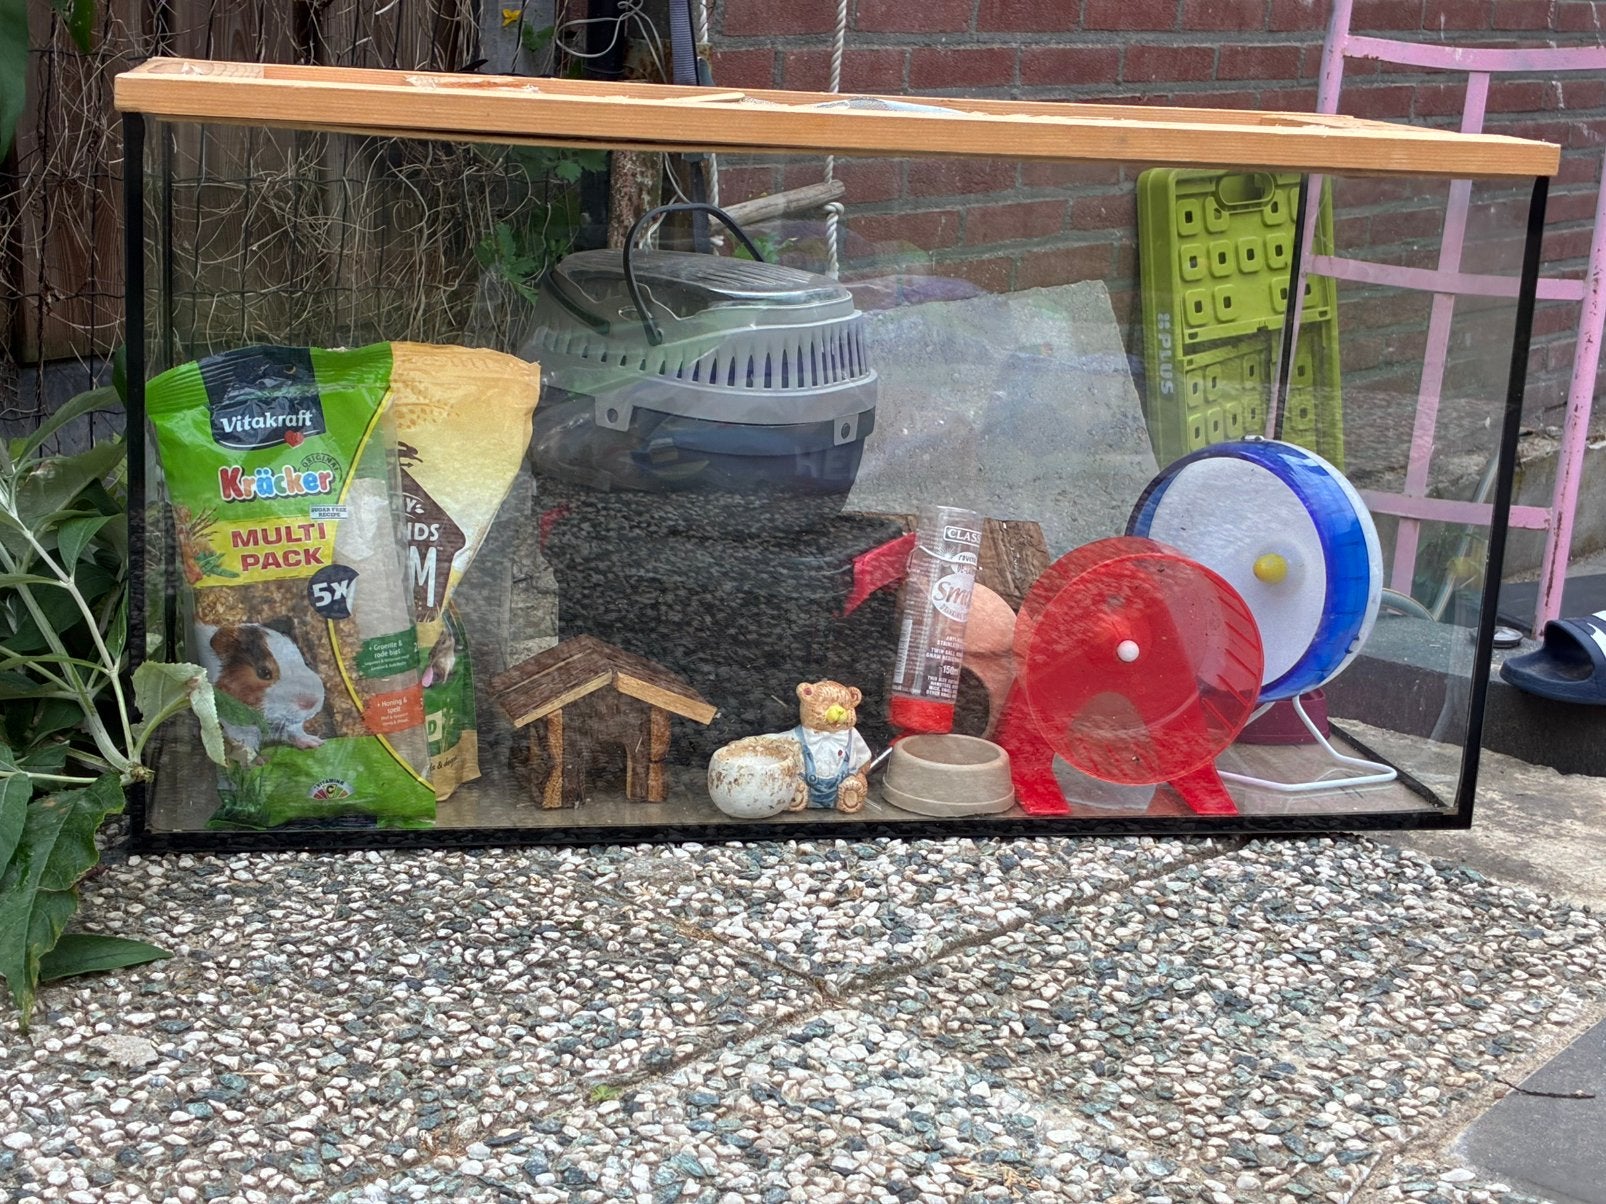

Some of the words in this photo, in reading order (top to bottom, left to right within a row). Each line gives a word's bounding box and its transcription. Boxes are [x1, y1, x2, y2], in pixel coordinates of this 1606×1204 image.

[1158, 333, 1174, 394] PLUS
[220, 410, 313, 433] Vitakraft
[219, 465, 333, 501] Kräcker
[231, 523, 326, 548] MULTI
[241, 547, 324, 571] PACK
